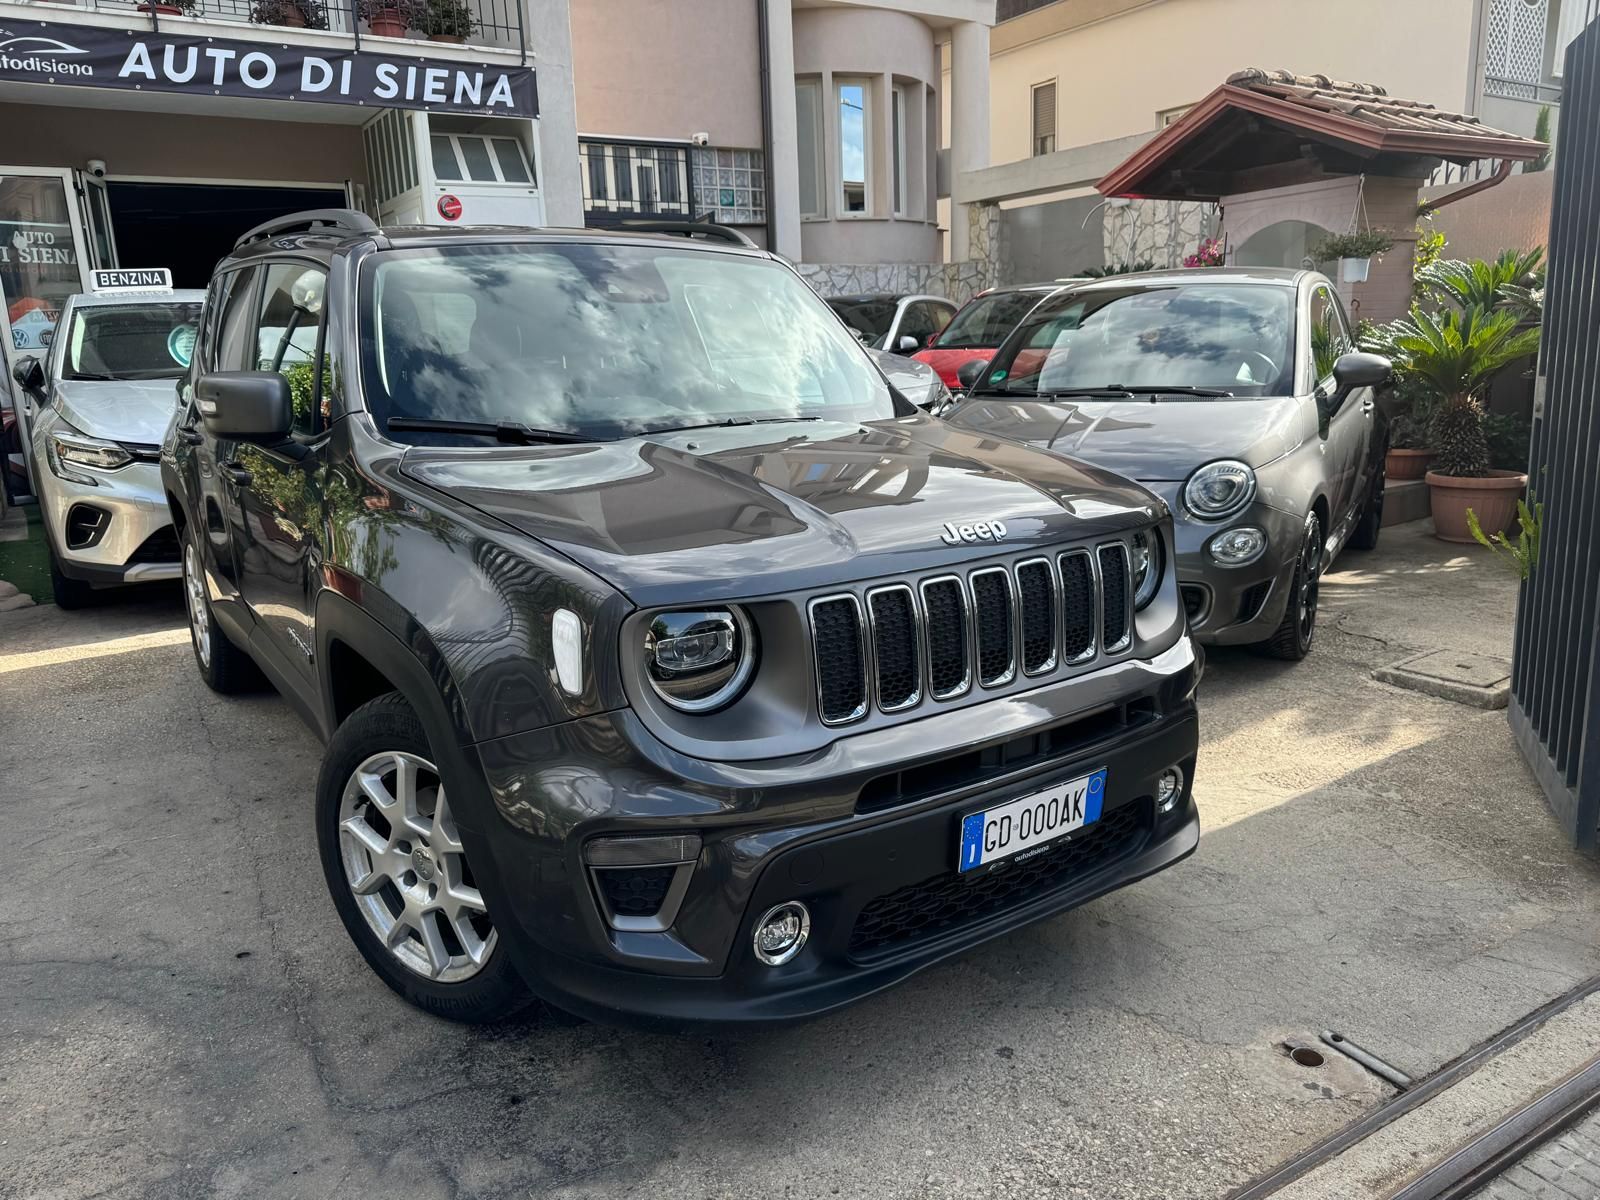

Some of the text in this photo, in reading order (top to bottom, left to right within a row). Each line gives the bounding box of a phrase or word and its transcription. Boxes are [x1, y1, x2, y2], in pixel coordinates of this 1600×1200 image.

[0, 55, 94, 76] todisiena
[118, 42, 515, 108] AUTO DI SIENA
[100, 272, 163, 286] BENZINA
[941, 520, 1007, 544] Jeep
